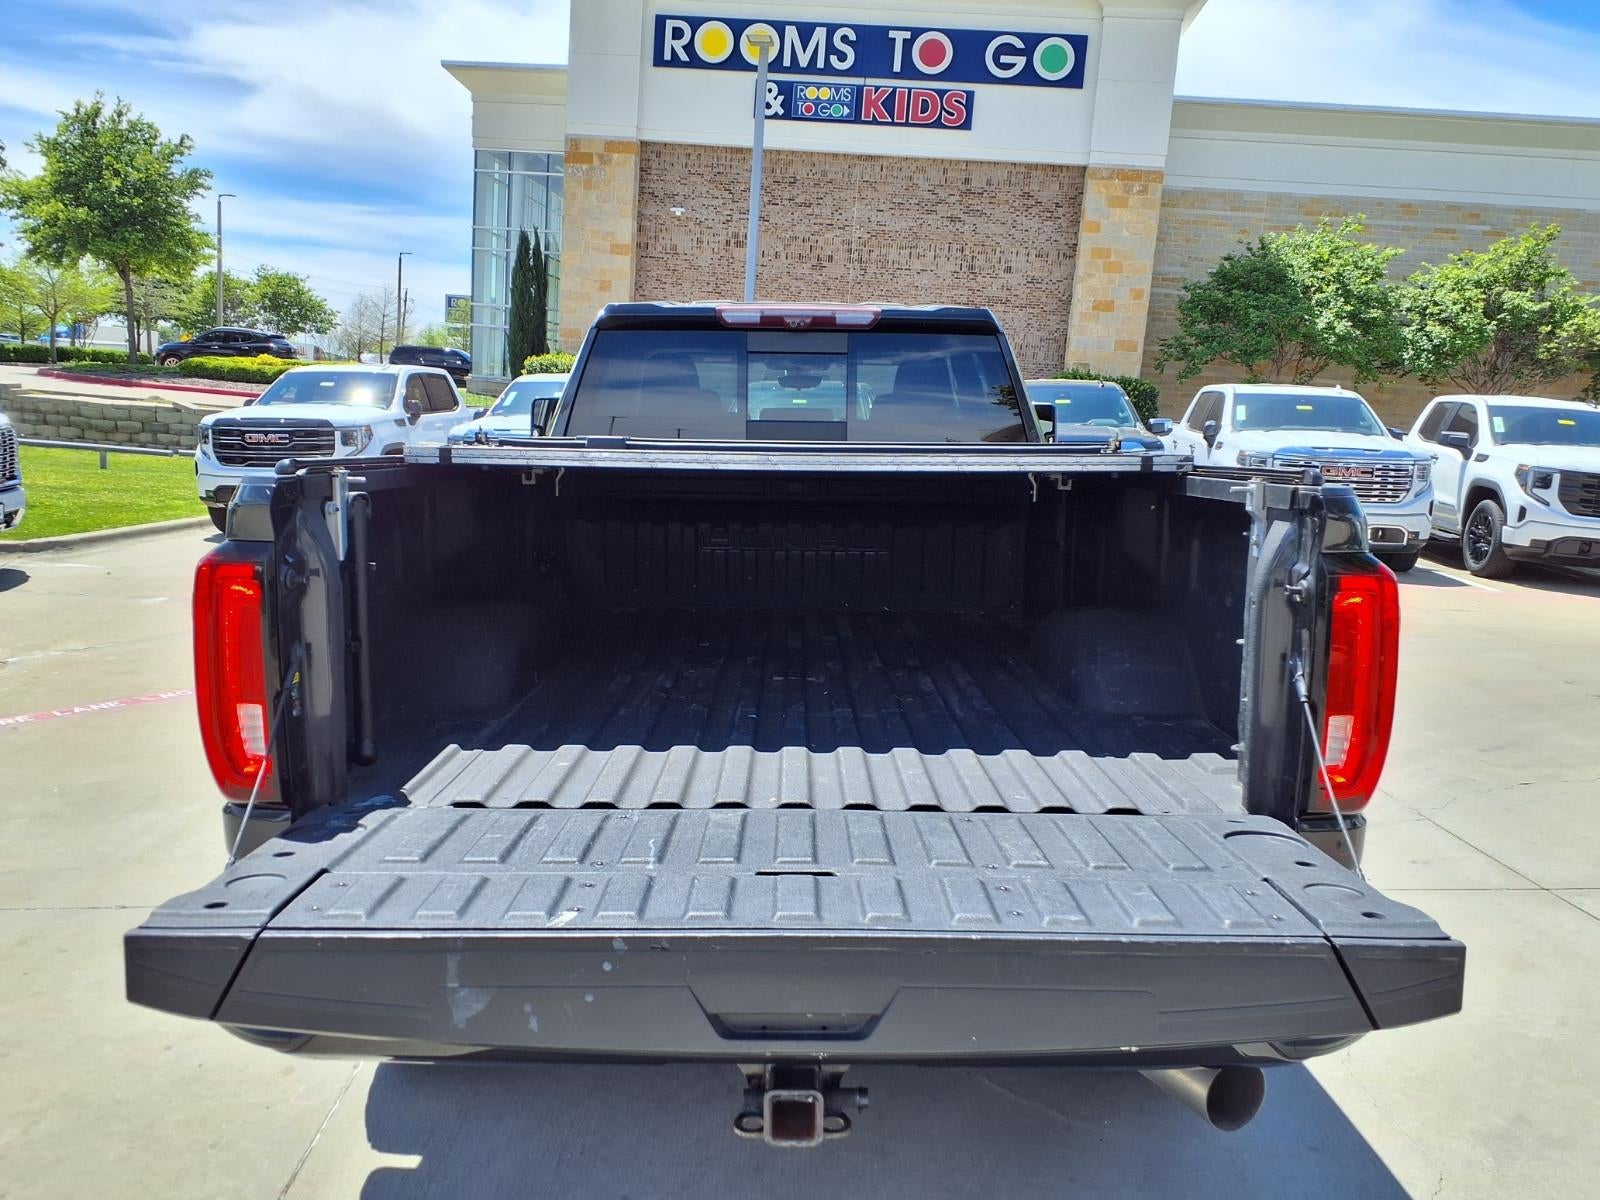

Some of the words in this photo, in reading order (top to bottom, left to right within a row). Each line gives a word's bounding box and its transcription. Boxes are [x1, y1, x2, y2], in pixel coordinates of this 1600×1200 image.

[664, 19, 857, 71] ROOMS
[888, 30, 954, 75] TO
[985, 34, 1076, 81] GO
[797, 85, 851, 101] ROOMS
[764, 81, 785, 116] &
[861, 86, 967, 127] KIDS
[797, 102, 815, 116] TO
[818, 103, 844, 117] GO
[245, 433, 289, 442] GMC
[1322, 467, 1373, 477] GMC
[51, 700, 125, 716] LANE
